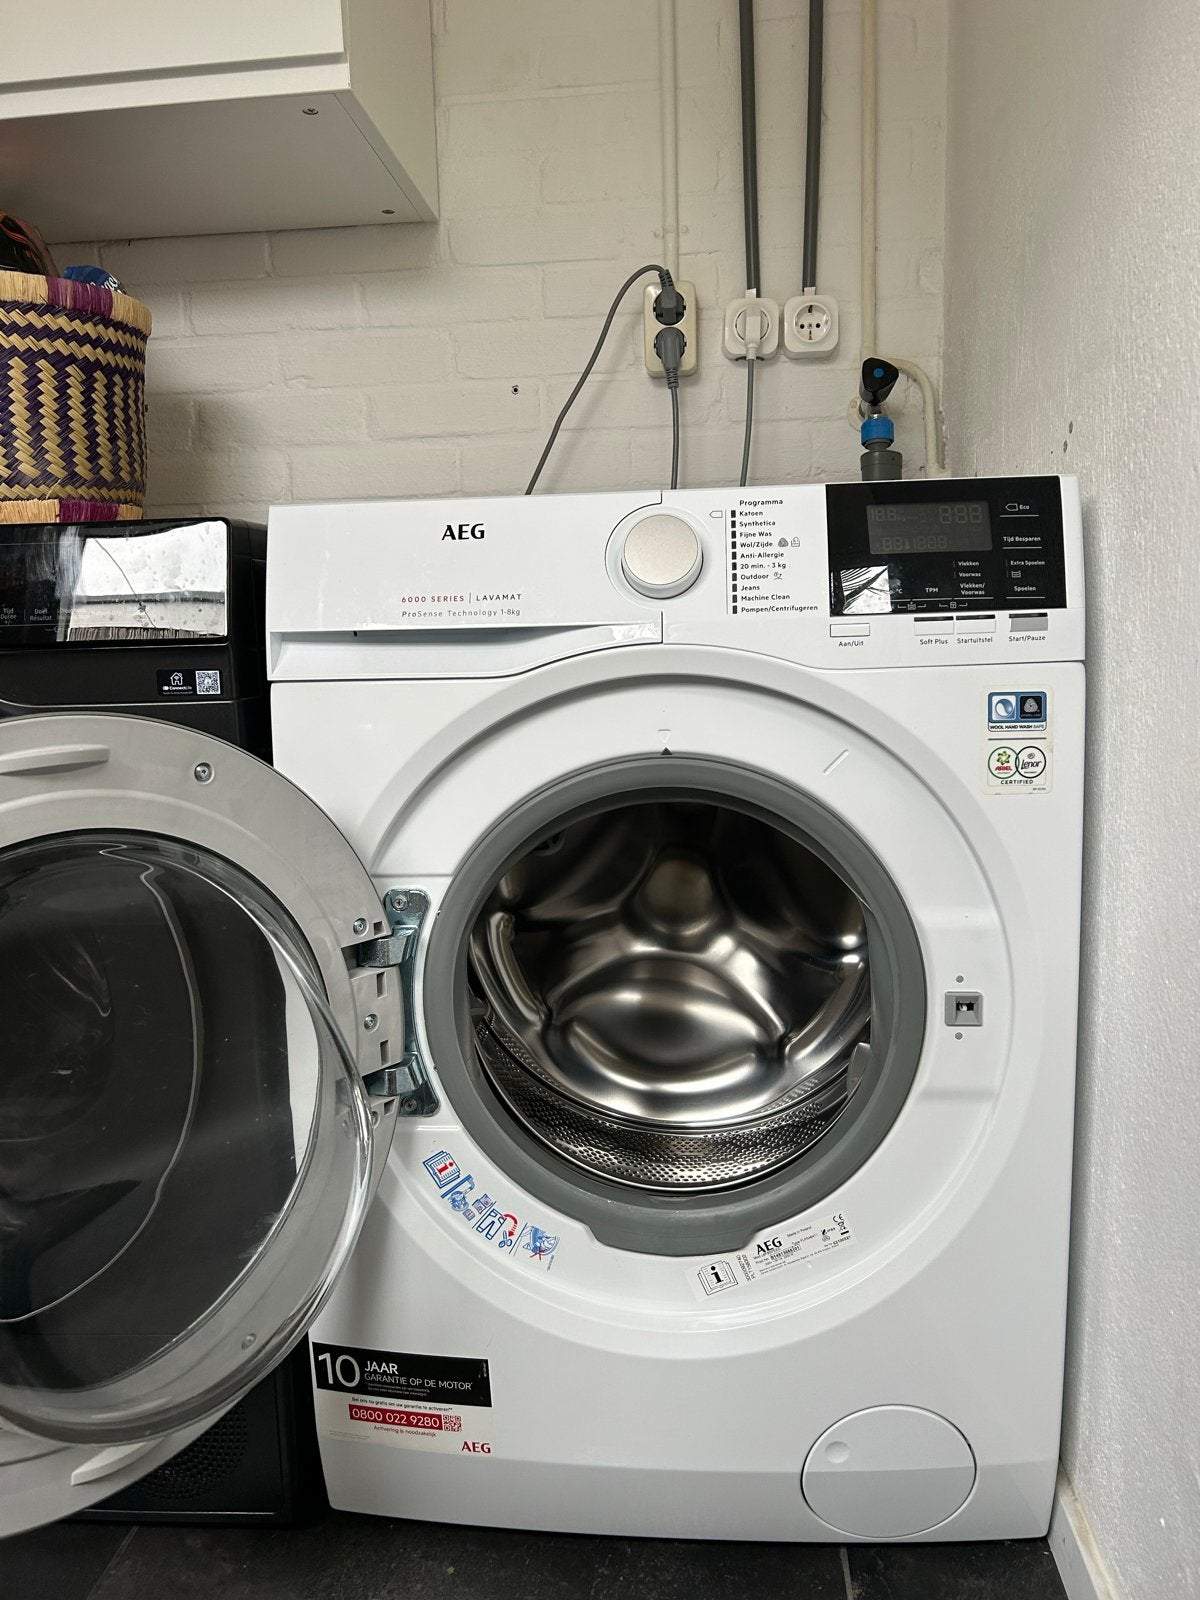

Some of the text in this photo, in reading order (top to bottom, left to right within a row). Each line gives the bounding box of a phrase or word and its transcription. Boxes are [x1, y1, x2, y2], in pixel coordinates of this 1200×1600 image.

[739, 499, 783, 507] Programma
[739, 520, 776, 528] Synthetica
[441, 522, 485, 541] AEG
[1015, 535, 1041, 543] Besparen
[777, 562, 787, 570] kg
[431, 595, 465, 603] SERIES
[476, 594, 522, 602] LAVAMAT
[741, 594, 770, 602] Machine
[401, 608, 521, 618] ProSense Technology 1-8kg
[741, 605, 818, 613] Pompen/Centrifugeren
[1009, 635, 1046, 643] Start/Pauze
[838, 640, 864, 648] Aan/Uit
[1020, 759, 1042, 770] Lenor
[756, 1236, 783, 1255] AEG
[318, 1352, 361, 1388] 10
[364, 1360, 399, 1375] JAAR
[364, 1372, 408, 1386] GARANTIE
[409, 1377, 423, 1387] OP
[424, 1379, 437, 1388] DE
[352, 1408, 440, 1428] 0800 022 9280
[373, 1425, 399, 1434] Activering
[405, 1429, 437, 1438] noodzakelijk
[461, 1441, 491, 1454] AEG
